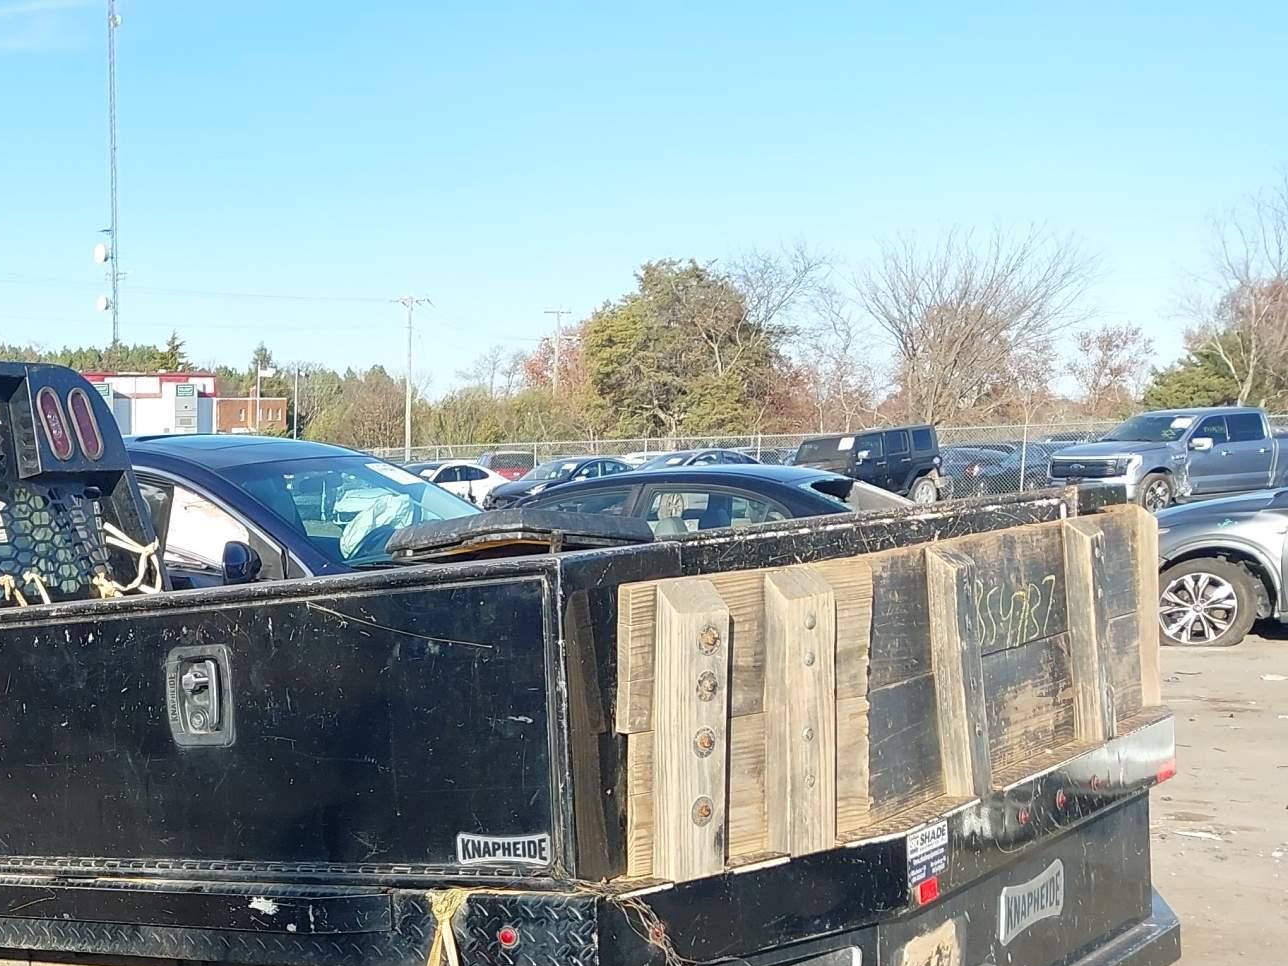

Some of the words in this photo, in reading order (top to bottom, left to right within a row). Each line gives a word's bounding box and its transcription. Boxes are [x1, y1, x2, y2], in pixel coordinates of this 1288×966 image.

[920, 823, 947, 846] SHADE
[462, 839, 548, 862] KNAPHEIDE
[1006, 873, 1062, 934] KNAPHEIDE
